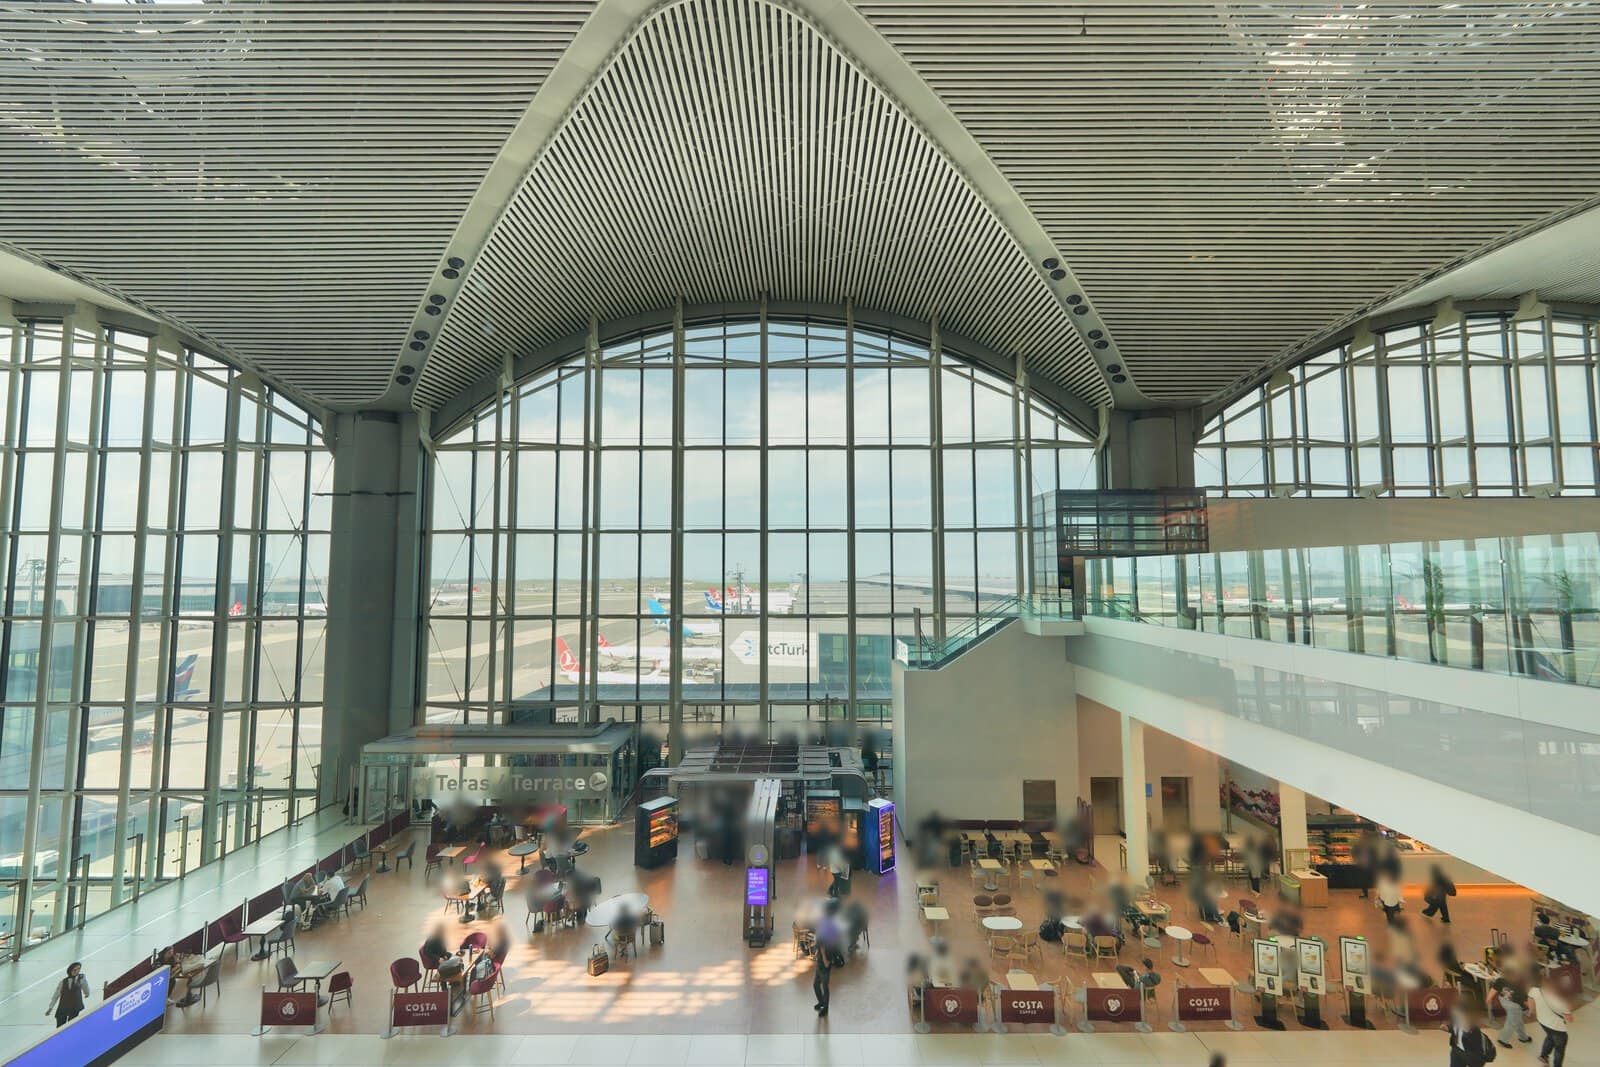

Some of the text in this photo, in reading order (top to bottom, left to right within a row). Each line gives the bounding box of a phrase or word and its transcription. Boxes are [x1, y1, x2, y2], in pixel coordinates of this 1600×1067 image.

[768, 642, 808, 656] tcTurk
[436, 774, 490, 791] Teras
[511, 774, 586, 791] Terrace
[405, 1003, 438, 1012] COSTA
[1012, 1000, 1044, 1010] COSTA
[1189, 998, 1221, 1007] COSTA
